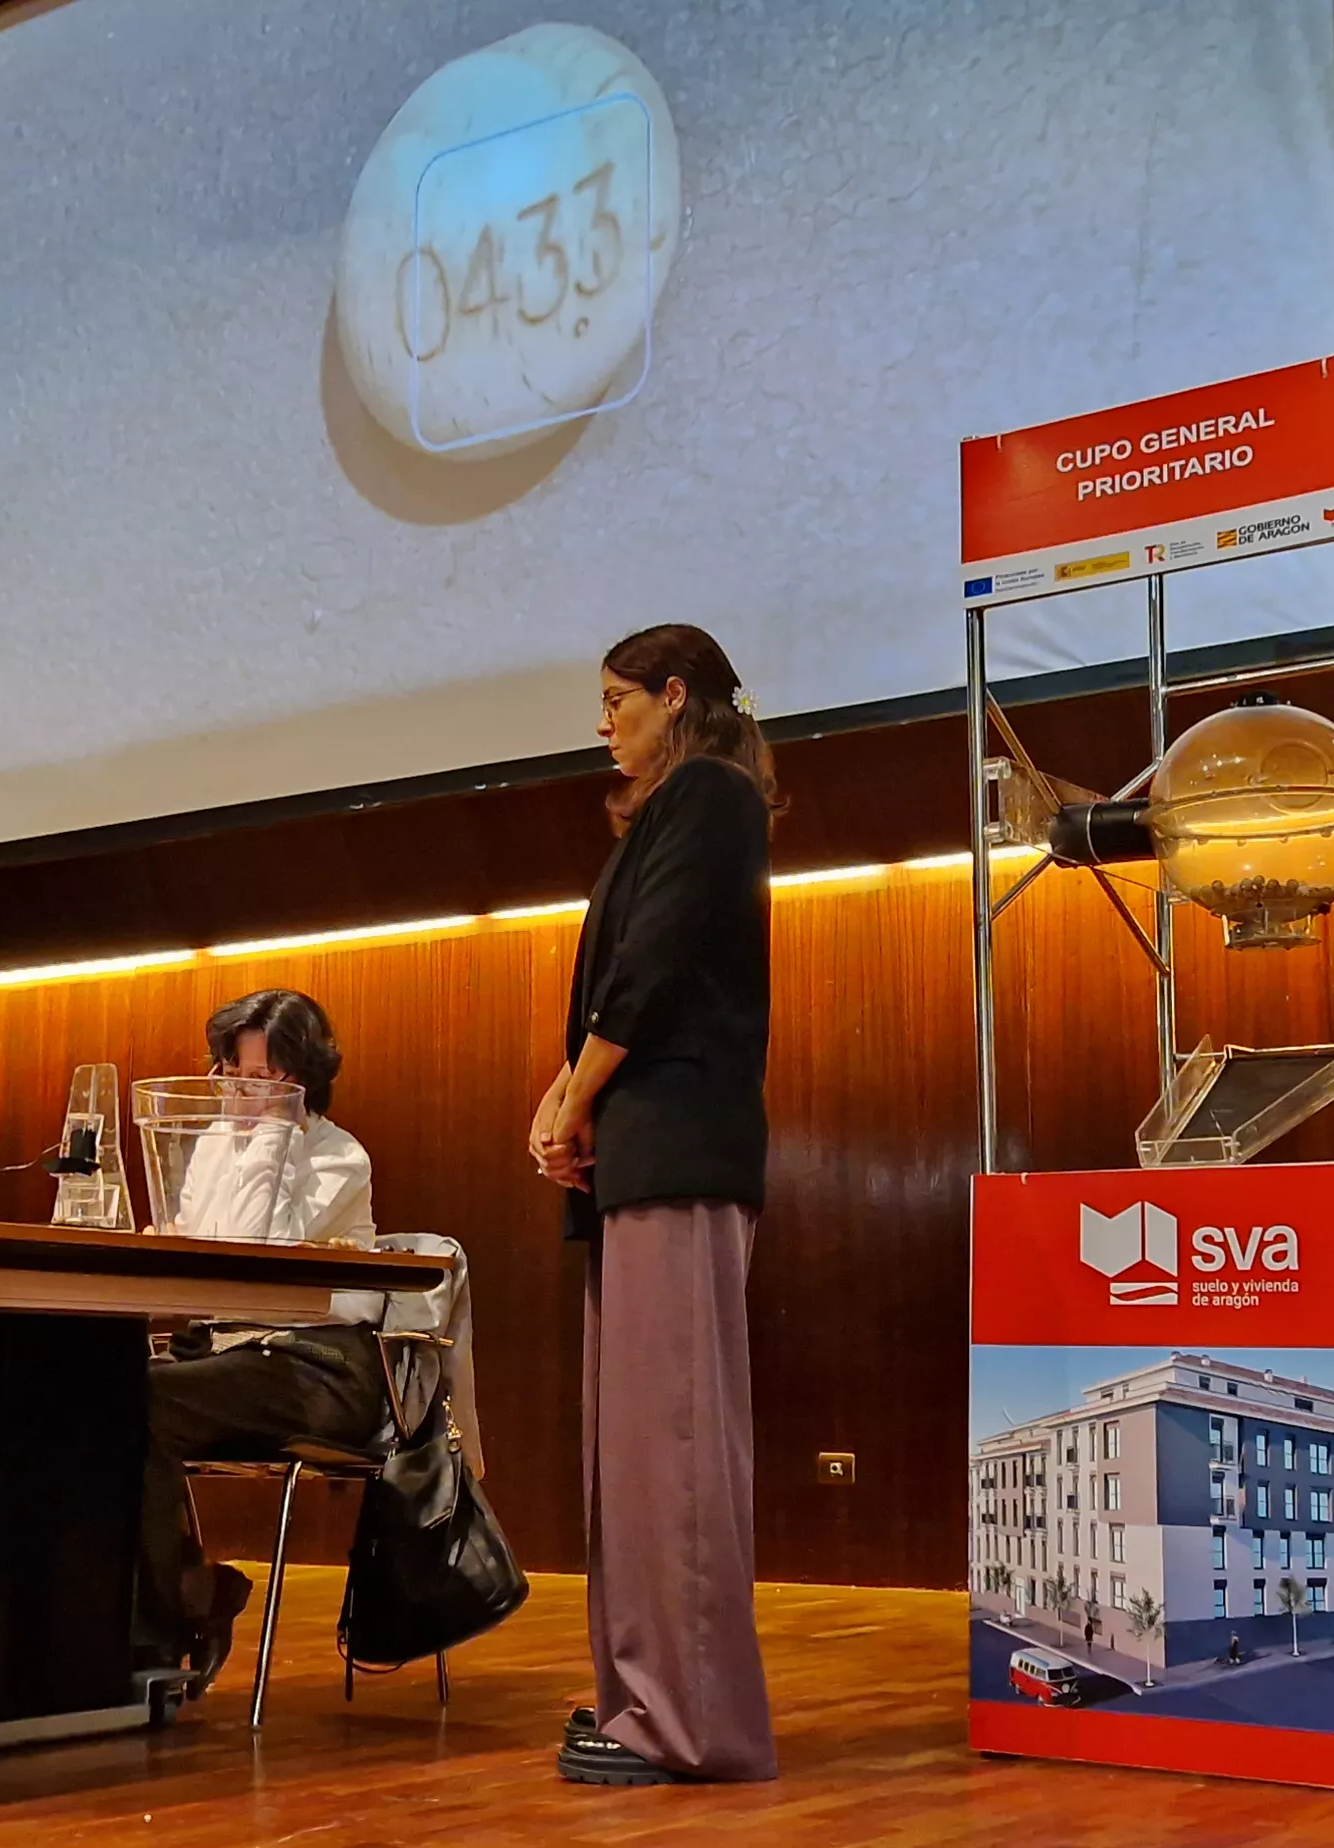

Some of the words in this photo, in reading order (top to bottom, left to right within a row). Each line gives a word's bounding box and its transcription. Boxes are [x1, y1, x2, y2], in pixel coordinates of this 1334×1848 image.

[1056, 439, 1133, 474] CUPO
[1140, 407, 1275, 454] GENERAL
[1077, 444, 1254, 502] PRIORITARIO
[1238, 514, 1301, 536] GOBIERNO
[1238, 534, 1254, 545] DE
[1191, 1225, 1299, 1272] sva
[1192, 1278, 1229, 1293] suelo
[1230, 1282, 1240, 1296] y
[1242, 1278, 1299, 1293] vivienda
[1192, 1292, 1210, 1306] de
[1211, 1292, 1260, 1310] aragón
